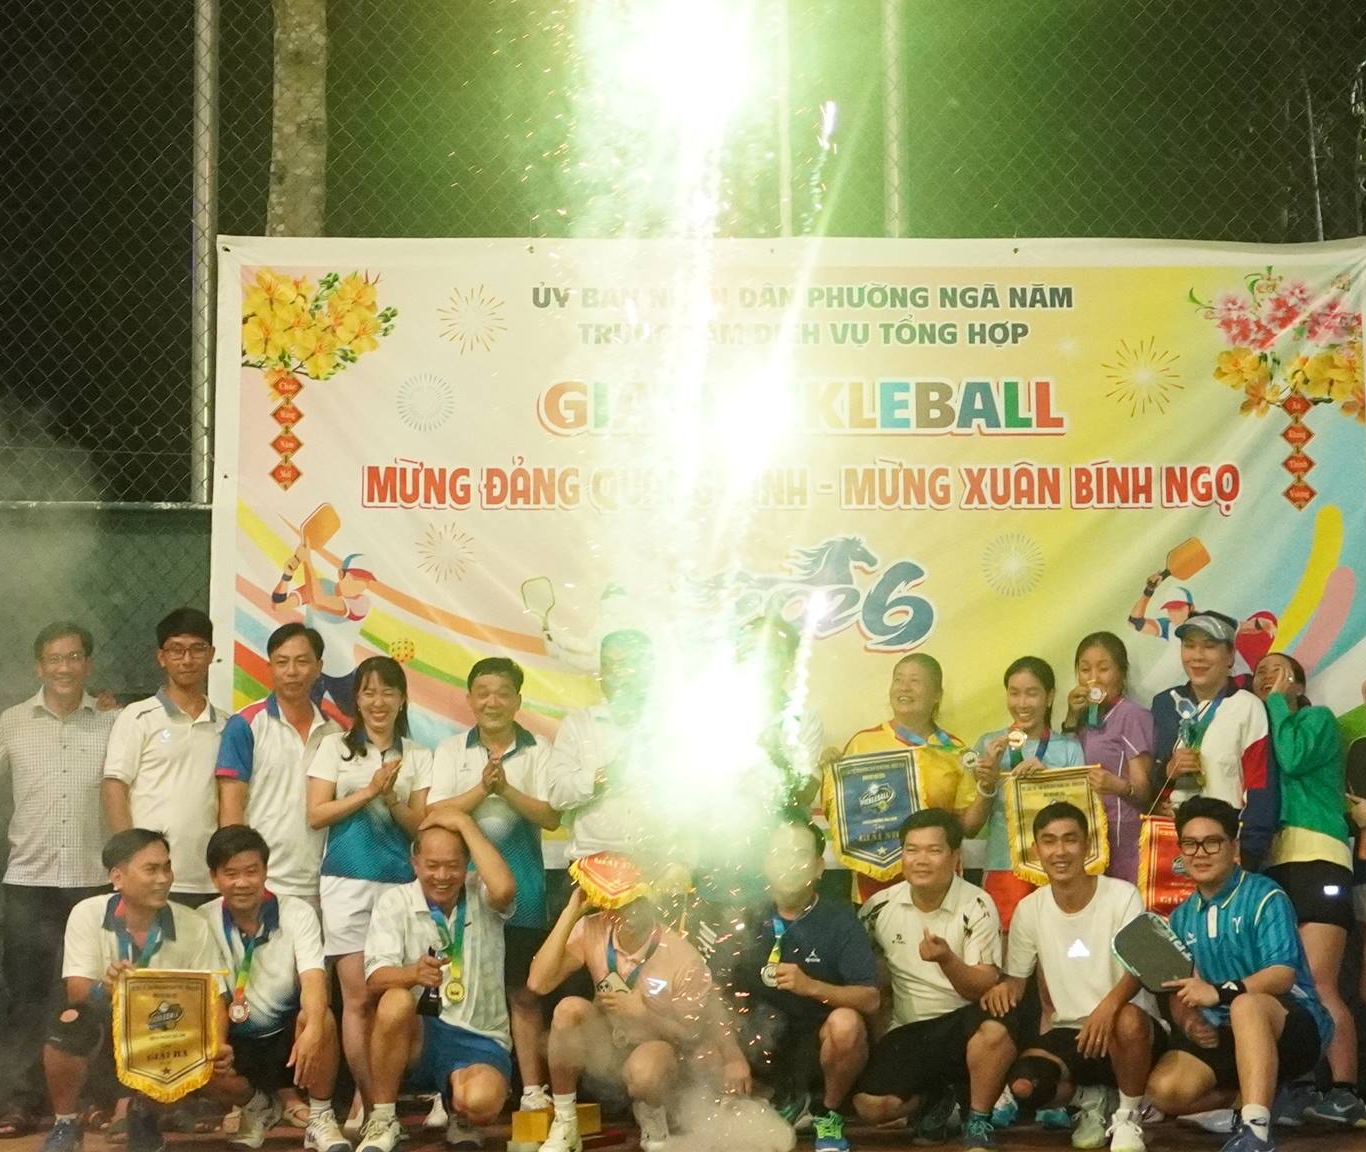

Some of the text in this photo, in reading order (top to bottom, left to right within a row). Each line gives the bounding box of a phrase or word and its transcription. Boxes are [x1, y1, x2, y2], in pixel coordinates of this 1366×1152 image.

[532, 280, 570, 309] ỦY
[739, 282, 796, 309] DÂN
[807, 283, 929, 309] PHƯỜNG
[939, 283, 1000, 309] NGÃ
[1009, 283, 1073, 309] NĂM
[830, 322, 870, 348] VỤ
[879, 313, 957, 345] TỔNG
[968, 321, 1029, 348] HỢP
[366, 457, 472, 506] MỪNG
[483, 456, 581, 506] ĐẢNG
[845, 458, 951, 506] MỪNG
[965, 459, 1061, 506] XUÂN
[1075, 458, 1153, 505] BÍNH
[1165, 465, 1241, 516] NGỌ
